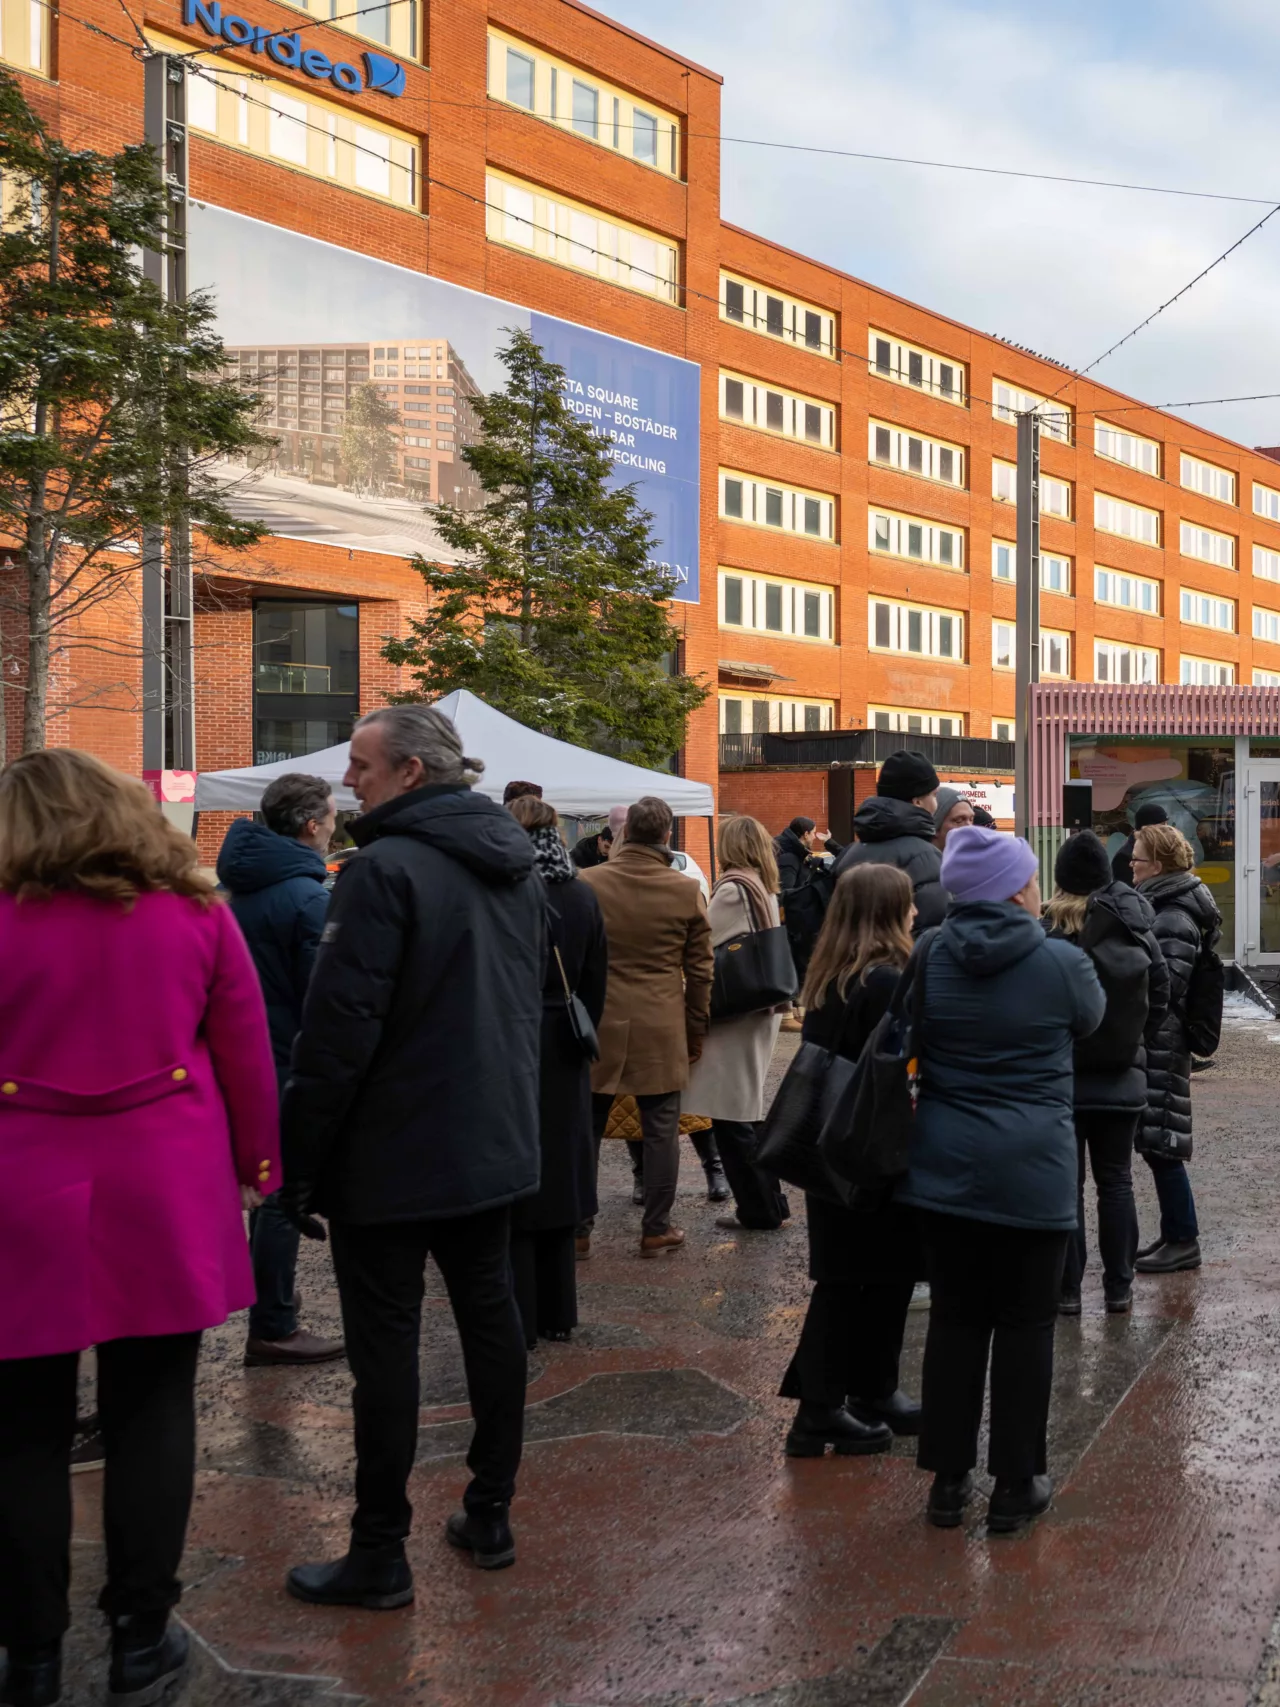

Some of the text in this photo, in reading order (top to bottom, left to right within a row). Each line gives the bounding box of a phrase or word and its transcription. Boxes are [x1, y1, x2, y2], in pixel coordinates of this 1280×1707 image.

[183, 0, 362, 94] Nordea
[587, 385, 639, 411] SQUARE
[614, 412, 677, 441] BOSTÄDER
